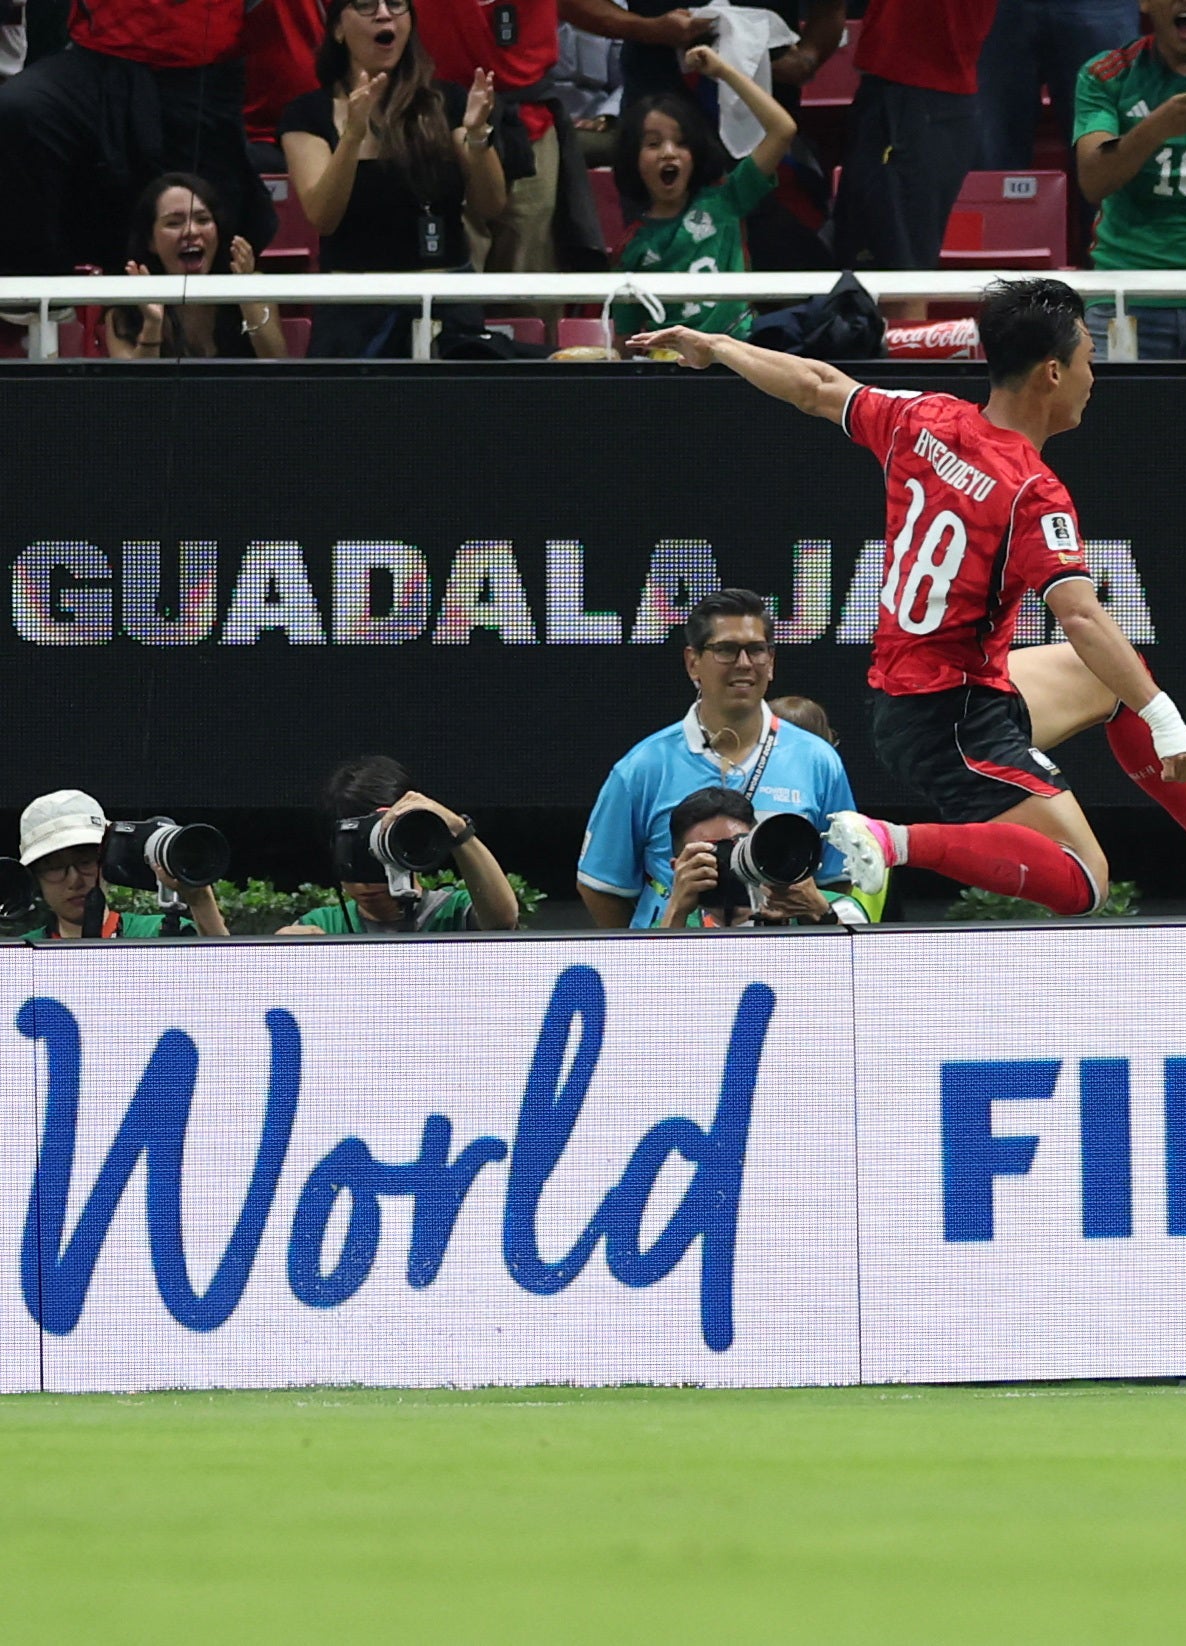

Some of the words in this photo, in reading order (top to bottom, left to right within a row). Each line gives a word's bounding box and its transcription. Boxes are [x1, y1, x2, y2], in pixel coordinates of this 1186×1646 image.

[1010, 181, 1030, 194] 10
[912, 427, 998, 502] HYEONGYU
[12, 540, 1158, 645] GUADALAJA
[880, 477, 968, 635] 18
[15, 964, 777, 1353] World
